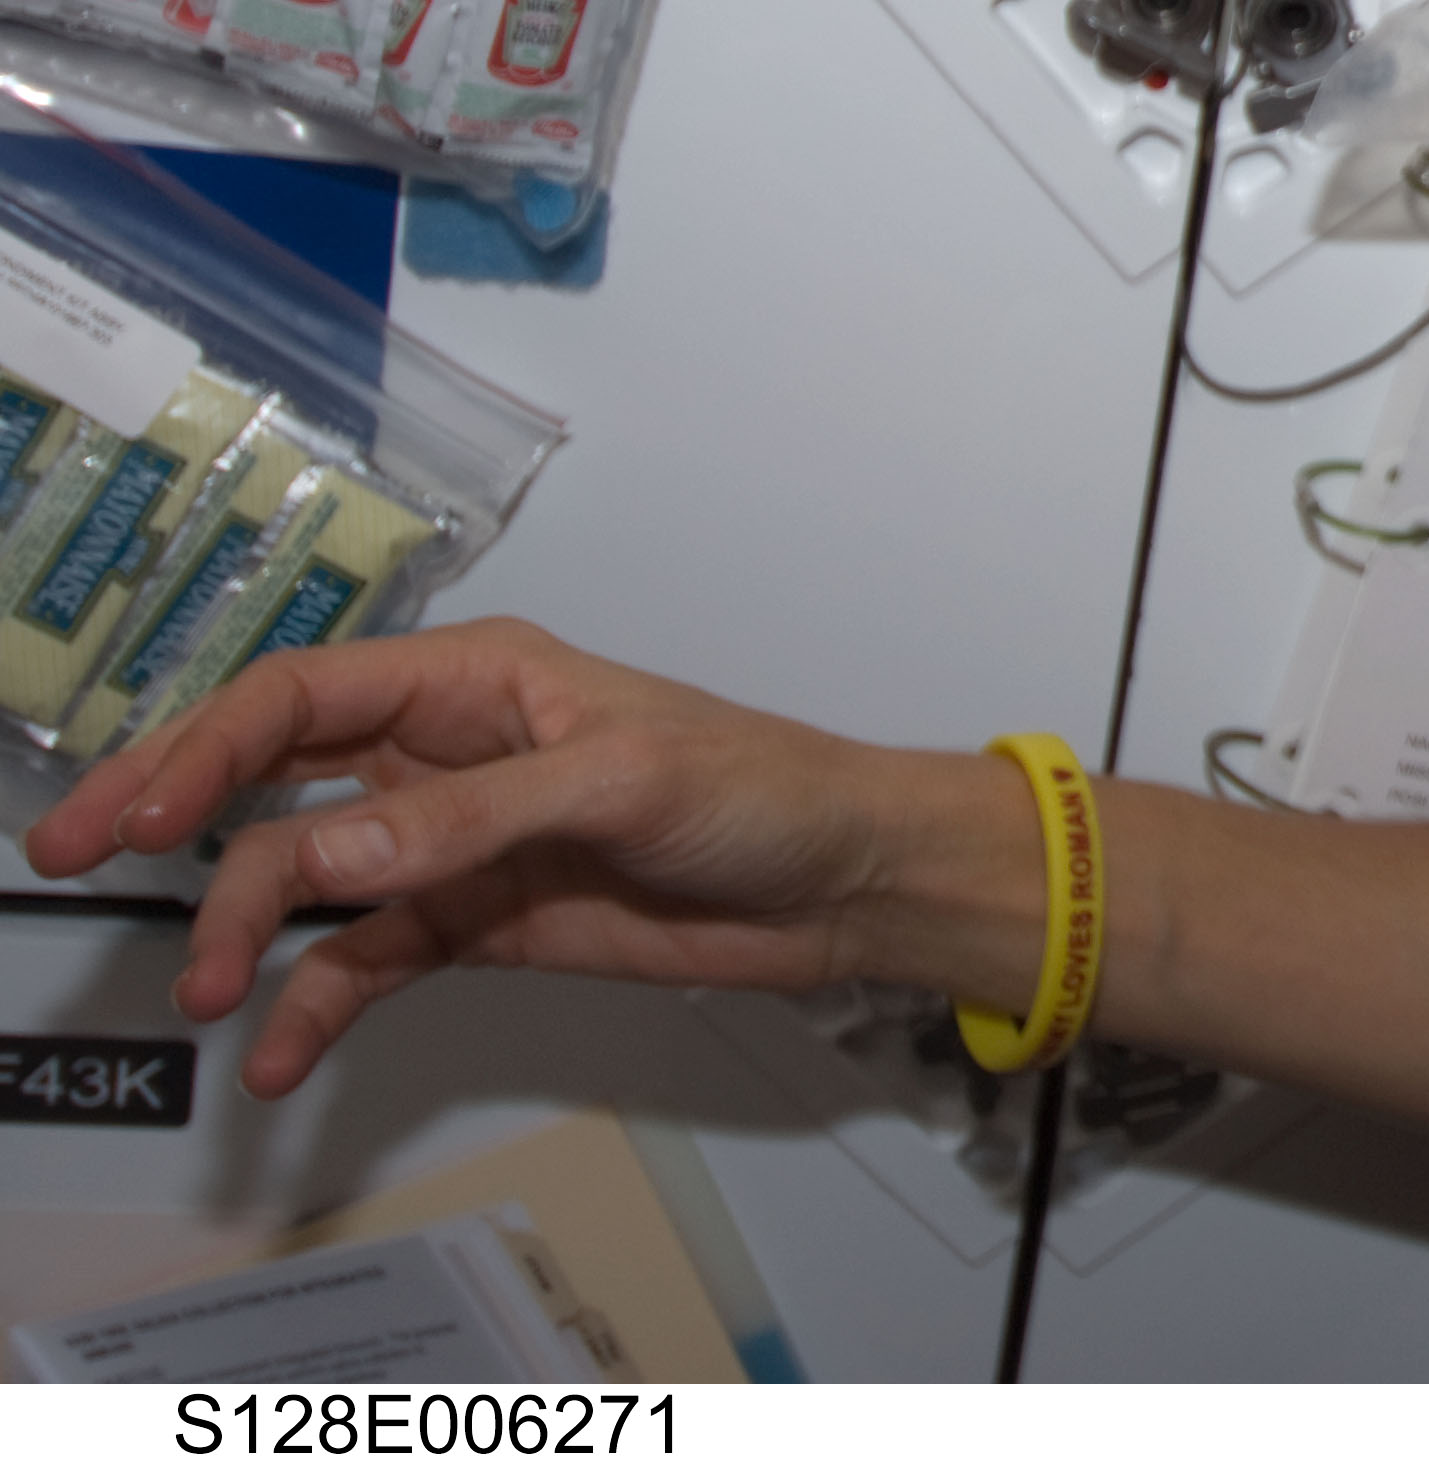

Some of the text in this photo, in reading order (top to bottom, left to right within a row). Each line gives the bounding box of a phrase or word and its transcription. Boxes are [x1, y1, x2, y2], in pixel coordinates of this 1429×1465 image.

[28, 455, 163, 616] MAYONNAISE
[1058, 791, 1094, 1009] LOVES ROMAN
